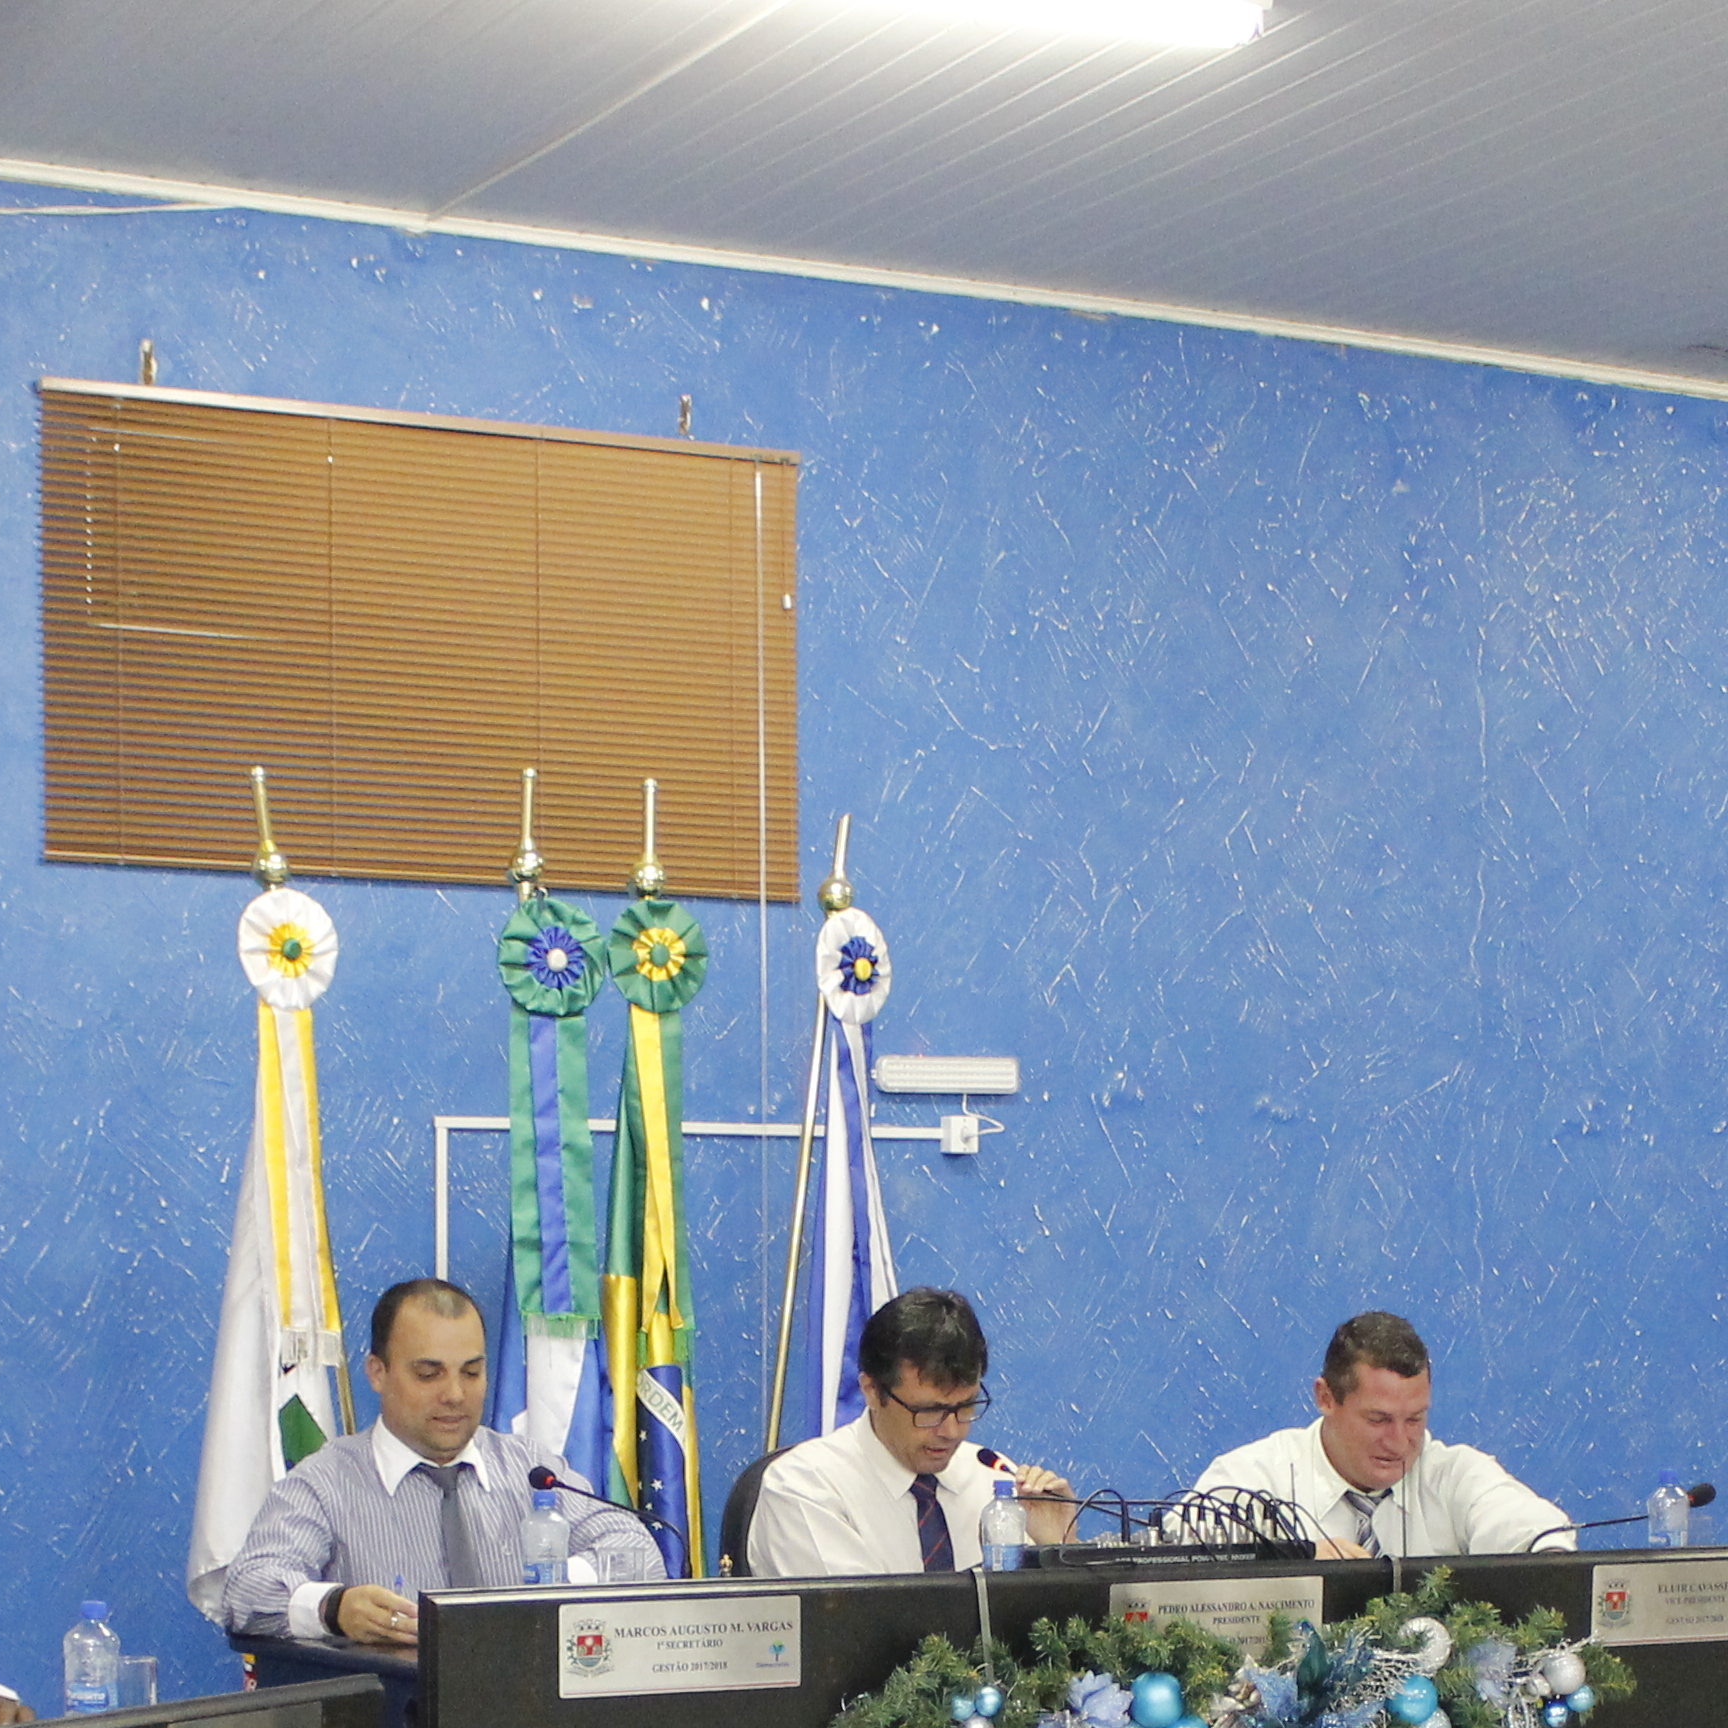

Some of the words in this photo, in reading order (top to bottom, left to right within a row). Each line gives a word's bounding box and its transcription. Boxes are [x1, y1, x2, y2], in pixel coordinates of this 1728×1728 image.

[1158, 1604, 1187, 1615] PEDRO
[1189, 1602, 1247, 1613] ALESSANDRO
[1259, 1599, 1315, 1611] NASCIMENTO
[1213, 1615, 1260, 1625] PRESIDENTE
[614, 1627, 667, 1639] MARCOS
[670, 1623, 727, 1636] AUGUSTO
[730, 1622, 744, 1634] M.
[746, 1620, 793, 1633] VARGAS
[666, 1637, 723, 1650] SECRETÁRIO
[652, 1661, 688, 1674] GESTÃO
[690, 1661, 728, 1672] 2017/2018
